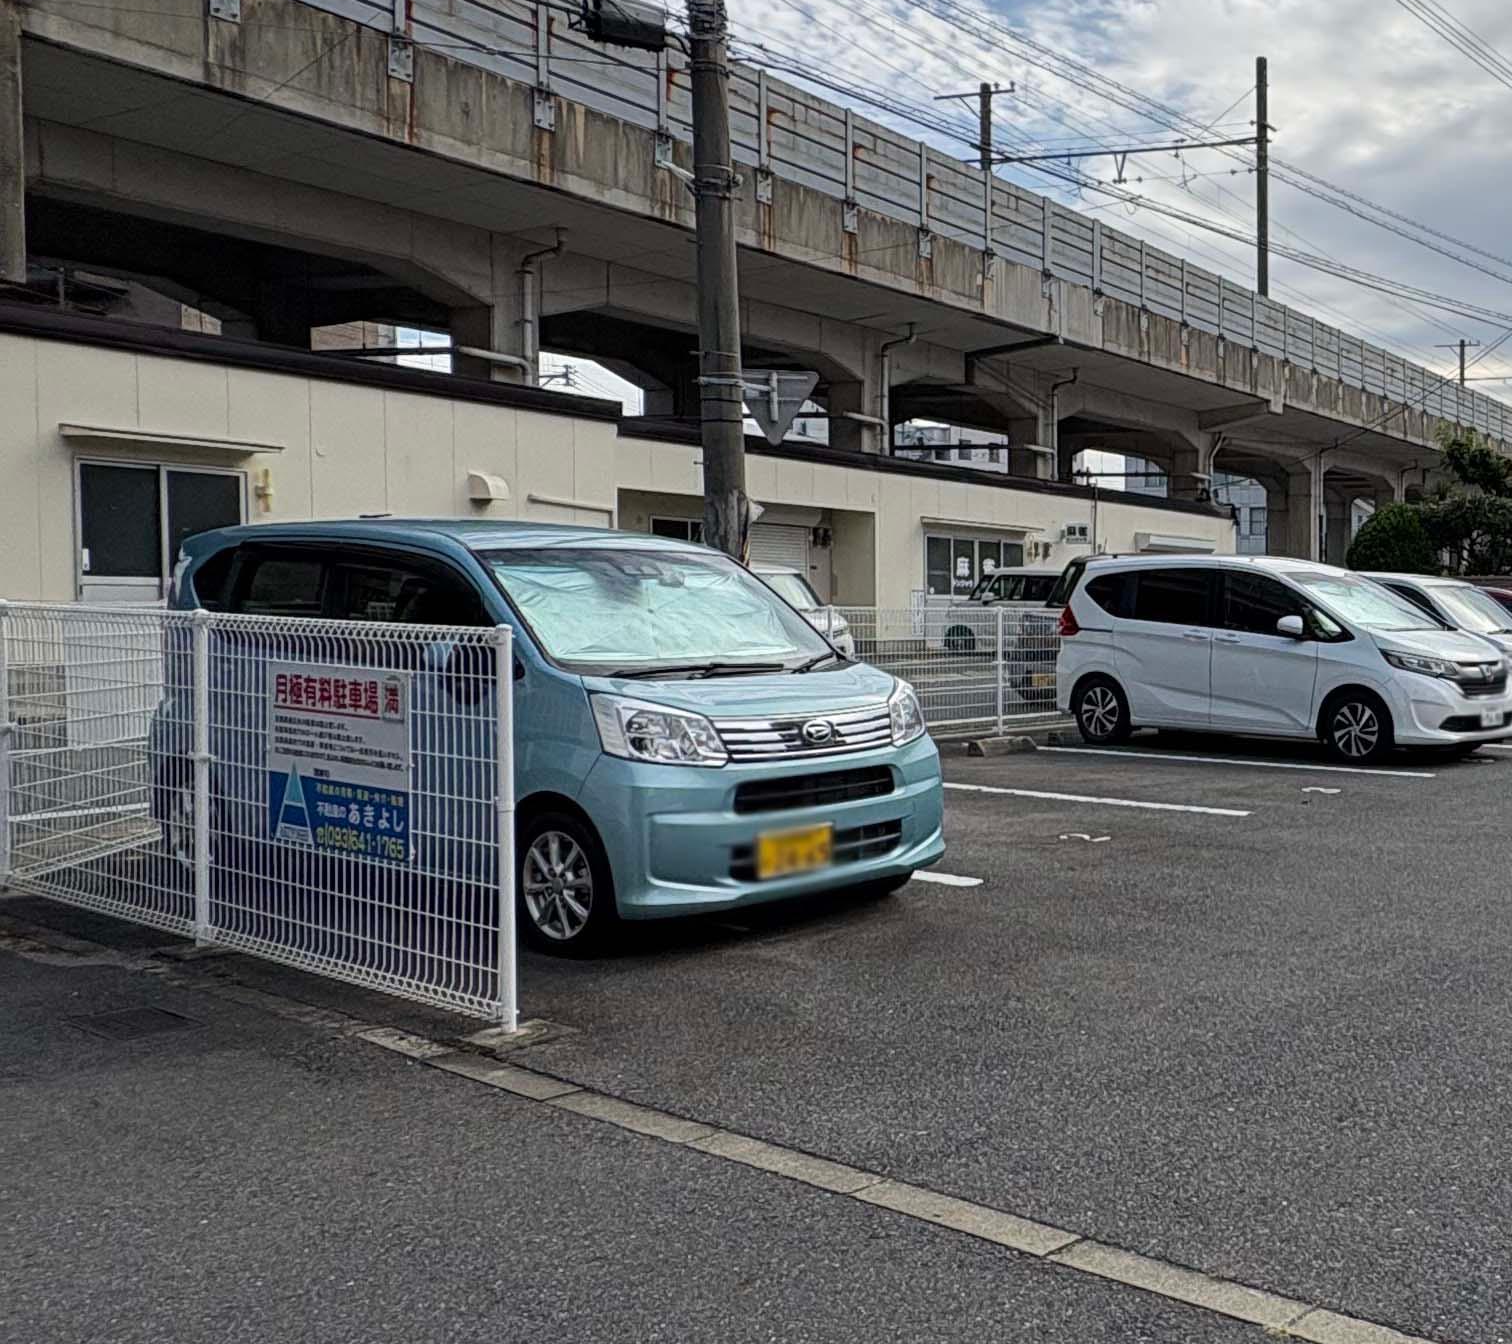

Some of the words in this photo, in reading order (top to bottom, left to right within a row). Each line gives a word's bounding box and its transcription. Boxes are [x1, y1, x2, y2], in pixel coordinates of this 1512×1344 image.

[275, 673, 379, 715] 月極有料駐車場
